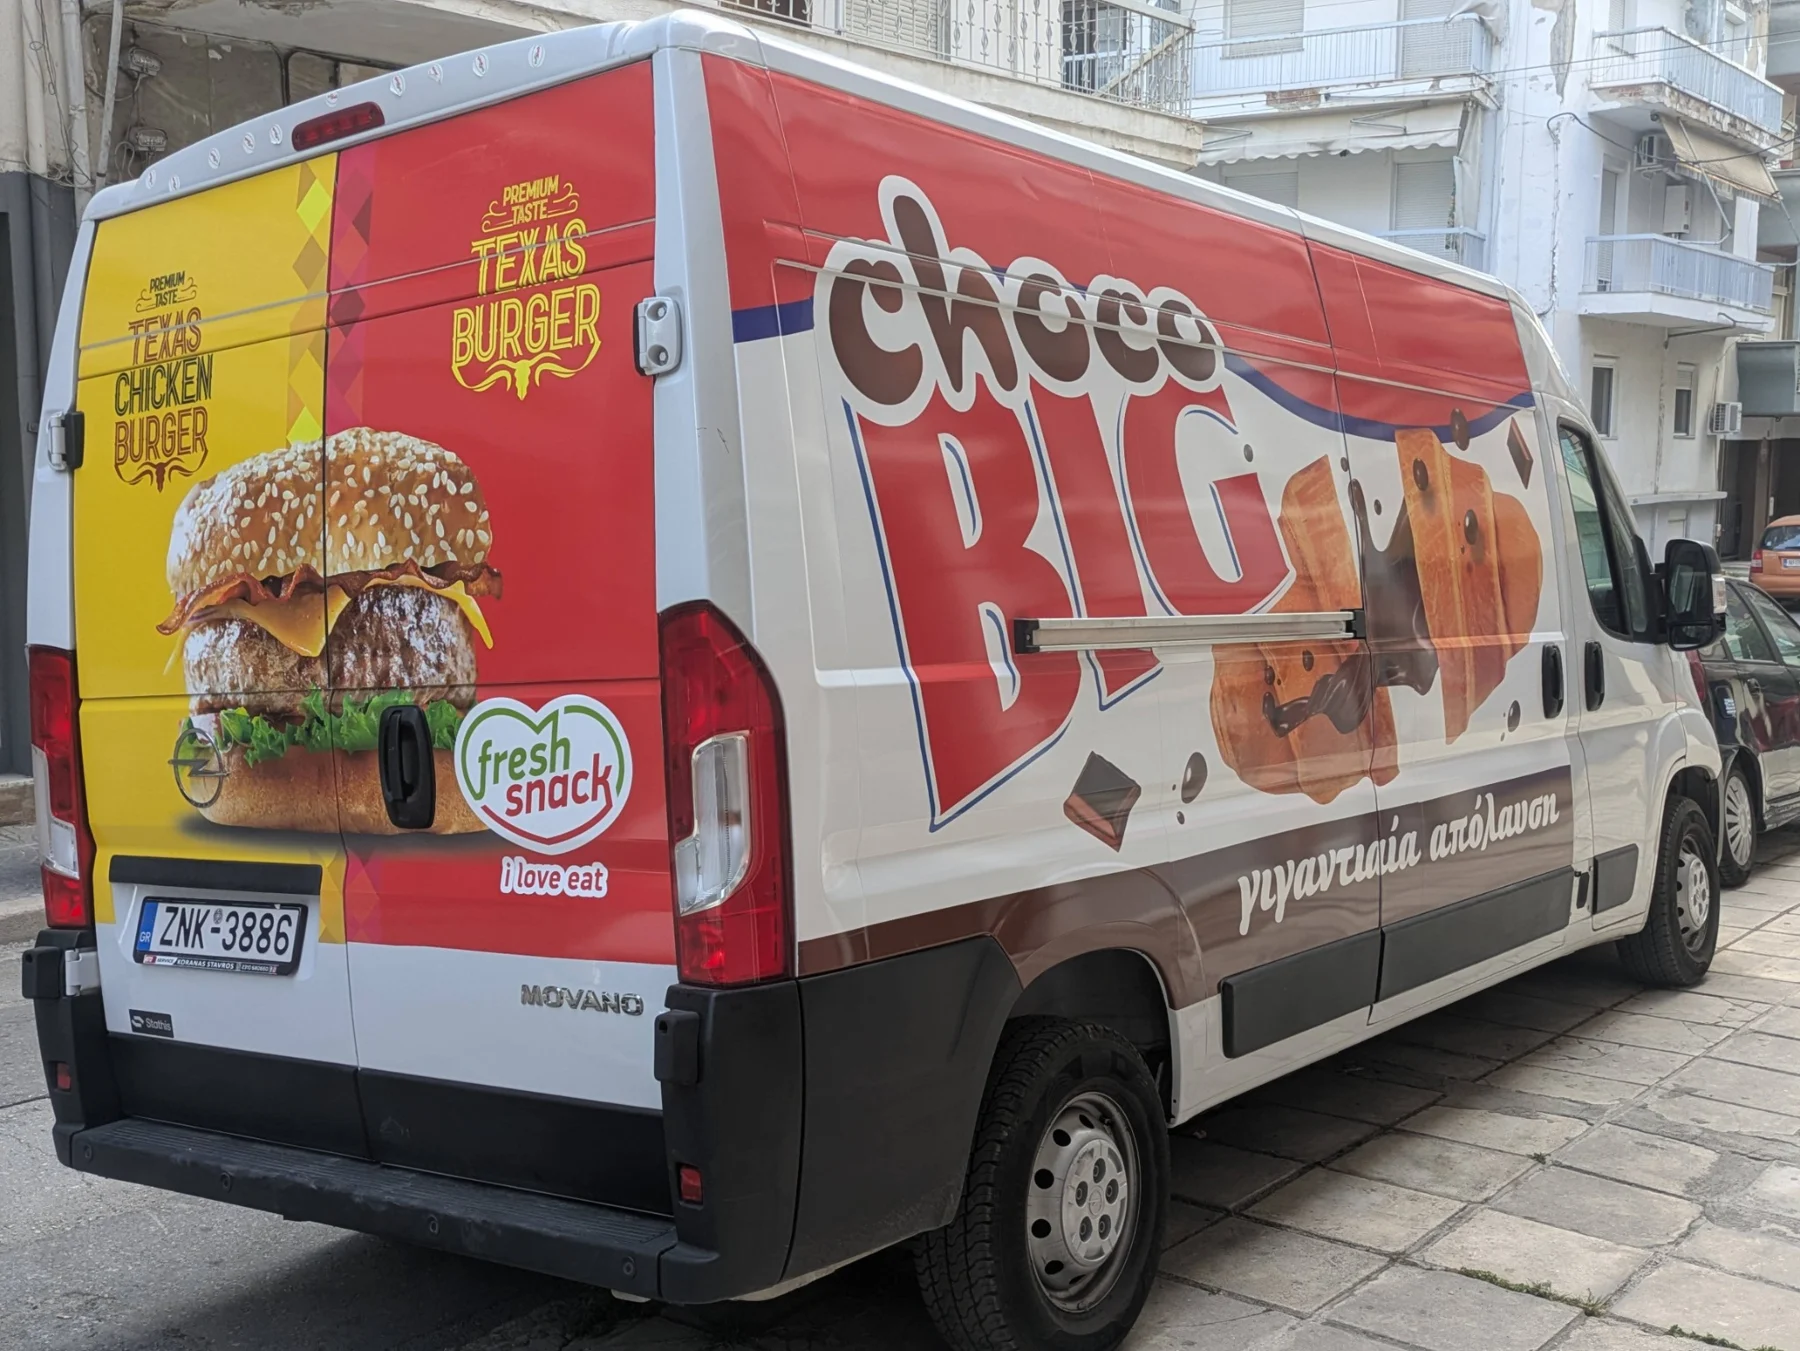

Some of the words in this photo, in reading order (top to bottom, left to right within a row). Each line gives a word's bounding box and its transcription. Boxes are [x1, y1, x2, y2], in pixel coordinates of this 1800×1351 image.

[503, 174, 559, 206] PREMIUM
[511, 198, 549, 225] TASTE
[149, 271, 186, 293] PREMIUM
[471, 218, 587, 297] TEXAS
[154, 288, 178, 307] TASTE
[452, 283, 601, 366] BURGER
[828, 194, 1217, 406] choco
[128, 306, 202, 365] TEXAS
[114, 353, 214, 416] CHICKEN
[114, 406, 209, 466] BURGER
[843, 374, 1293, 832] BIG
[475, 709, 571, 800] fresh
[505, 753, 613, 817] snack
[504, 862, 511, 887] i
[517, 863, 561, 889] love
[567, 868, 604, 891] eat
[1237, 815, 1421, 935] γιγαντιαία
[1429, 792, 1560, 861] απόλαυση
[139, 931, 150, 943] GR
[176, 959, 206, 967] KORANAS
[206, 961, 235, 970] STAVROS
[145, 1017, 172, 1031] Stathis
[520, 984, 644, 1016] MOVANO
